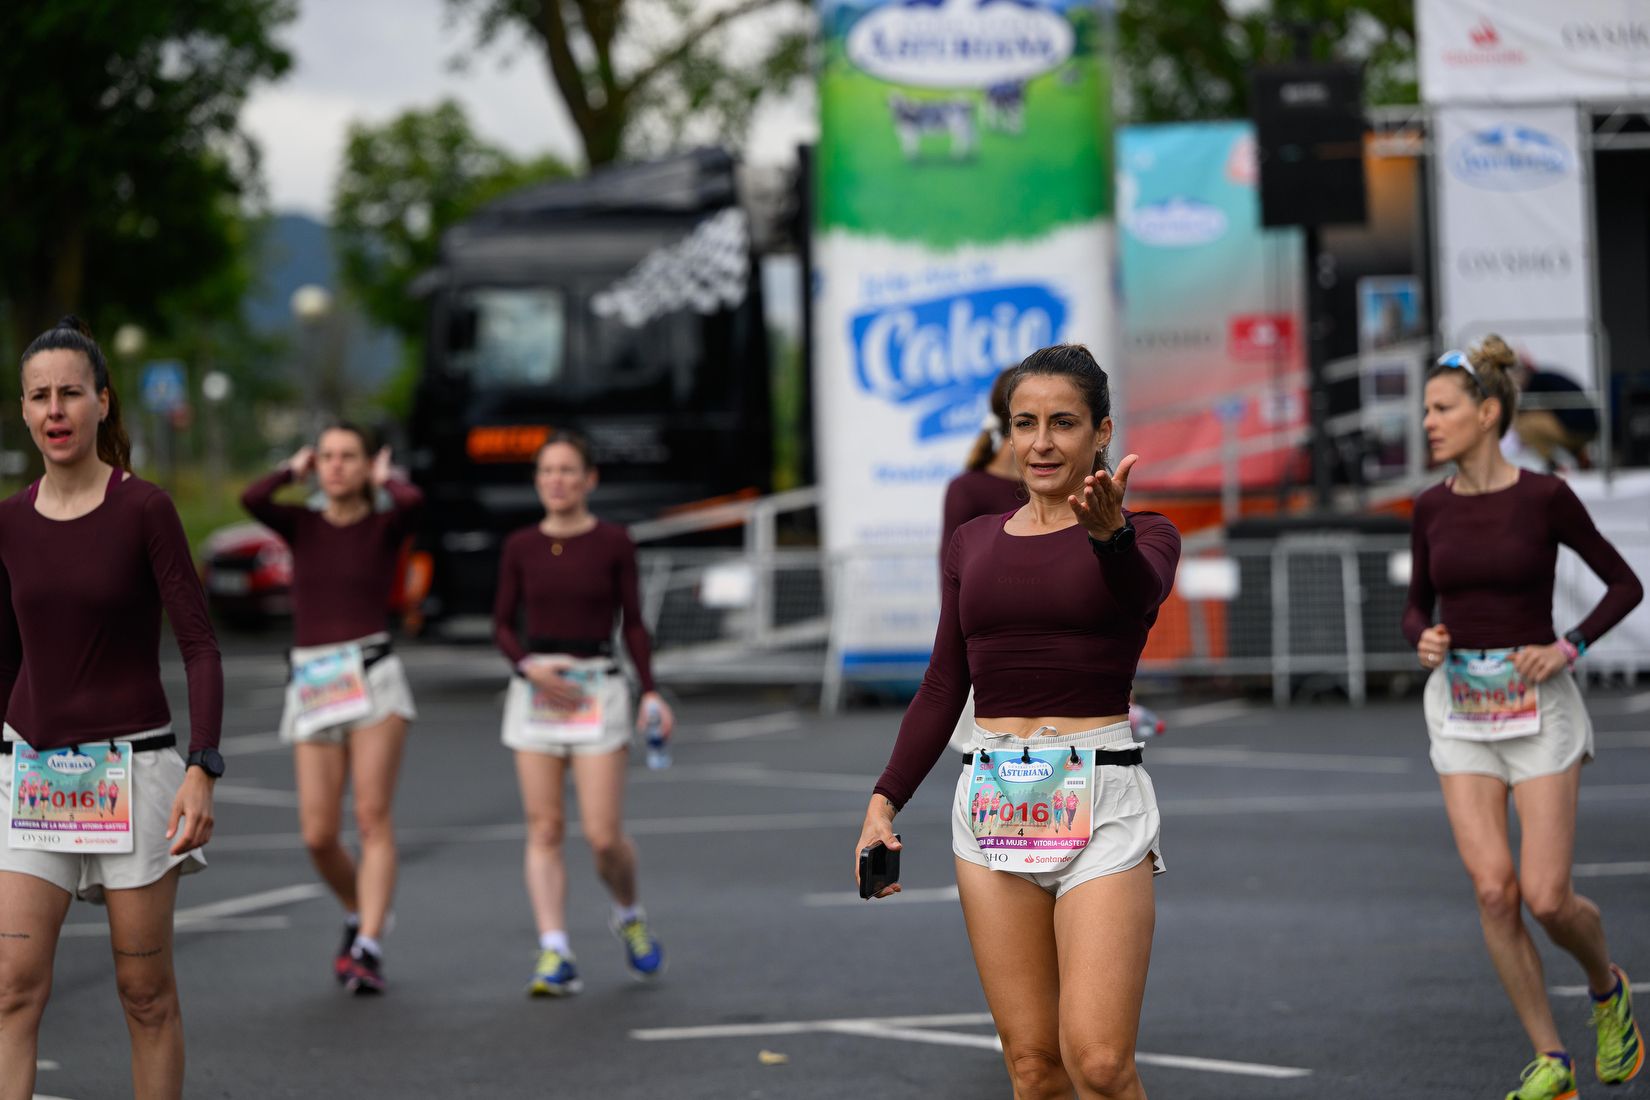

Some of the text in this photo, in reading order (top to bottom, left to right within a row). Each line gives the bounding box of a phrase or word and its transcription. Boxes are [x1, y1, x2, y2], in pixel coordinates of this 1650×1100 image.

[51, 759, 93, 770] ASTURIANA
[1001, 766, 1049, 777] ASTURIANA
[51, 791, 95, 808] 016
[1000, 802, 1049, 822] 016
[22, 833, 61, 843] OYSHO
[1017, 828, 1024, 837] 4
[987, 838, 994, 846] DE
